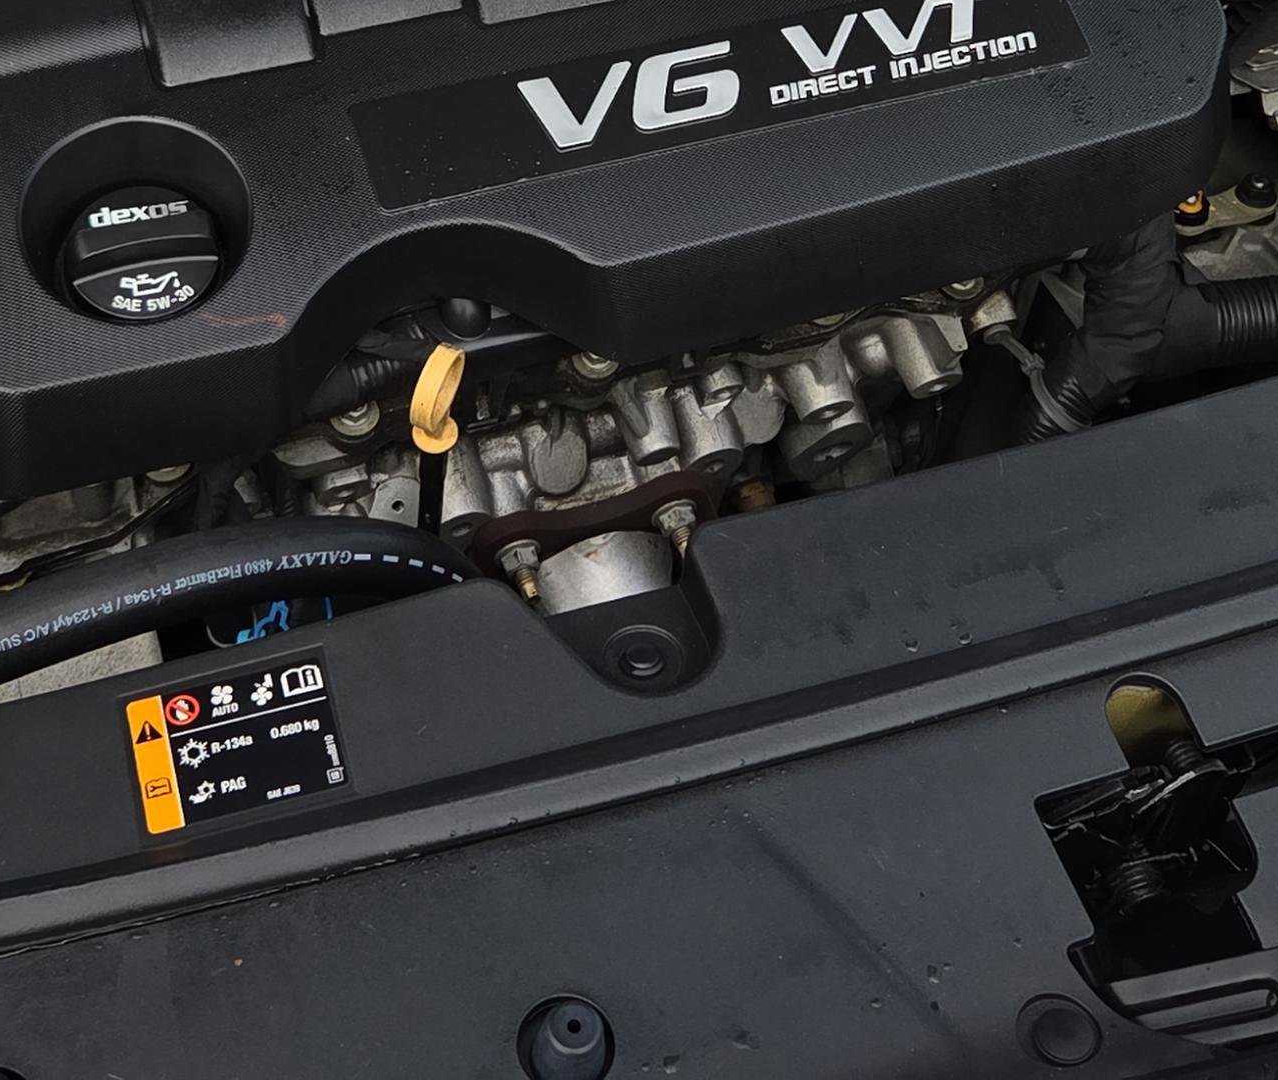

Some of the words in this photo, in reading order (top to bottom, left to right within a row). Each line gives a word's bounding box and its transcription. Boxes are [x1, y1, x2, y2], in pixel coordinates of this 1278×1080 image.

[770, 65, 877, 106] DIRECT
[890, 31, 1037, 80] INJECTION
[518, 40, 741, 150] V6
[89, 200, 189, 228] dexos
[111, 295, 142, 312] SAE
[146, 284, 195, 311] 5W-30
[244, 559, 273, 576] 4880
[276, 550, 352, 571] GALAXY
[175, 563, 242, 591] FlexBarrier
[116, 596, 121, 611] /
[123, 582, 172, 606] R-134a
[53, 599, 114, 632] R-1234yf
[25, 620, 50, 641] A/C
[211, 702, 239, 718] AUTO
[211, 735, 254, 754] R-134a
[269, 721, 302, 739] 0.680
[303, 719, 320, 733] kg
[220, 776, 247, 794] PAG
